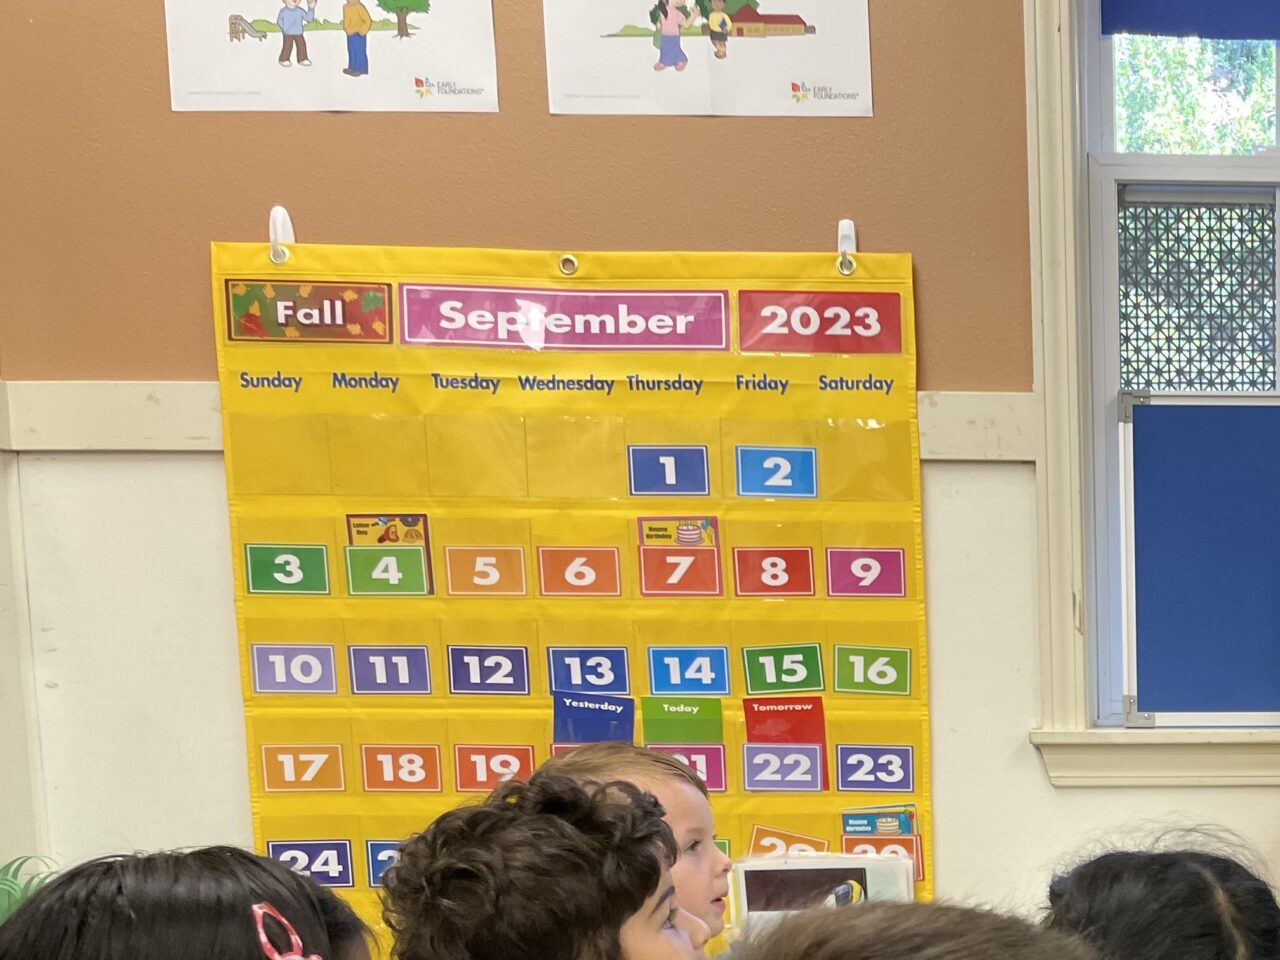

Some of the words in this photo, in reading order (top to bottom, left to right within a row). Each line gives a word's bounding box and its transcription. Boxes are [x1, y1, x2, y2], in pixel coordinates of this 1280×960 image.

[276, 299, 344, 326] Fall
[439, 301, 694, 339] September
[760, 305, 881, 337] 2023
[240, 371, 302, 393] Sunday
[332, 373, 399, 393] Monday
[432, 373, 501, 394] Tuesday
[518, 374, 615, 395] Wednesday
[626, 374, 703, 395] Thursday
[736, 374, 789, 395] Friday
[818, 374, 893, 395] Saturday
[659, 456, 676, 485] 1
[762, 457, 793, 487] 2
[273, 555, 304, 584] 3
[372, 556, 403, 585] 4
[473, 557, 500, 586] 5
[564, 557, 596, 586] 6
[666, 556, 695, 584] 7
[761, 557, 789, 587] 8
[850, 556, 882, 586] 9
[269, 654, 323, 684] 10
[369, 655, 409, 684] 11
[464, 655, 514, 685] 12
[564, 656, 615, 686] 13
[664, 656, 715, 685] 14
[758, 653, 808, 684] 15
[848, 655, 898, 685] 16
[563, 698, 624, 713] Yesterday
[663, 702, 699, 714] Today
[753, 702, 813, 713] Tomorrow
[278, 754, 329, 782] 17
[378, 754, 426, 783] 18
[470, 754, 520, 782] 19
[680, 753, 707, 781] 1
[752, 752, 812, 784] 22
[846, 753, 905, 783] 23
[279, 849, 343, 877] 24
